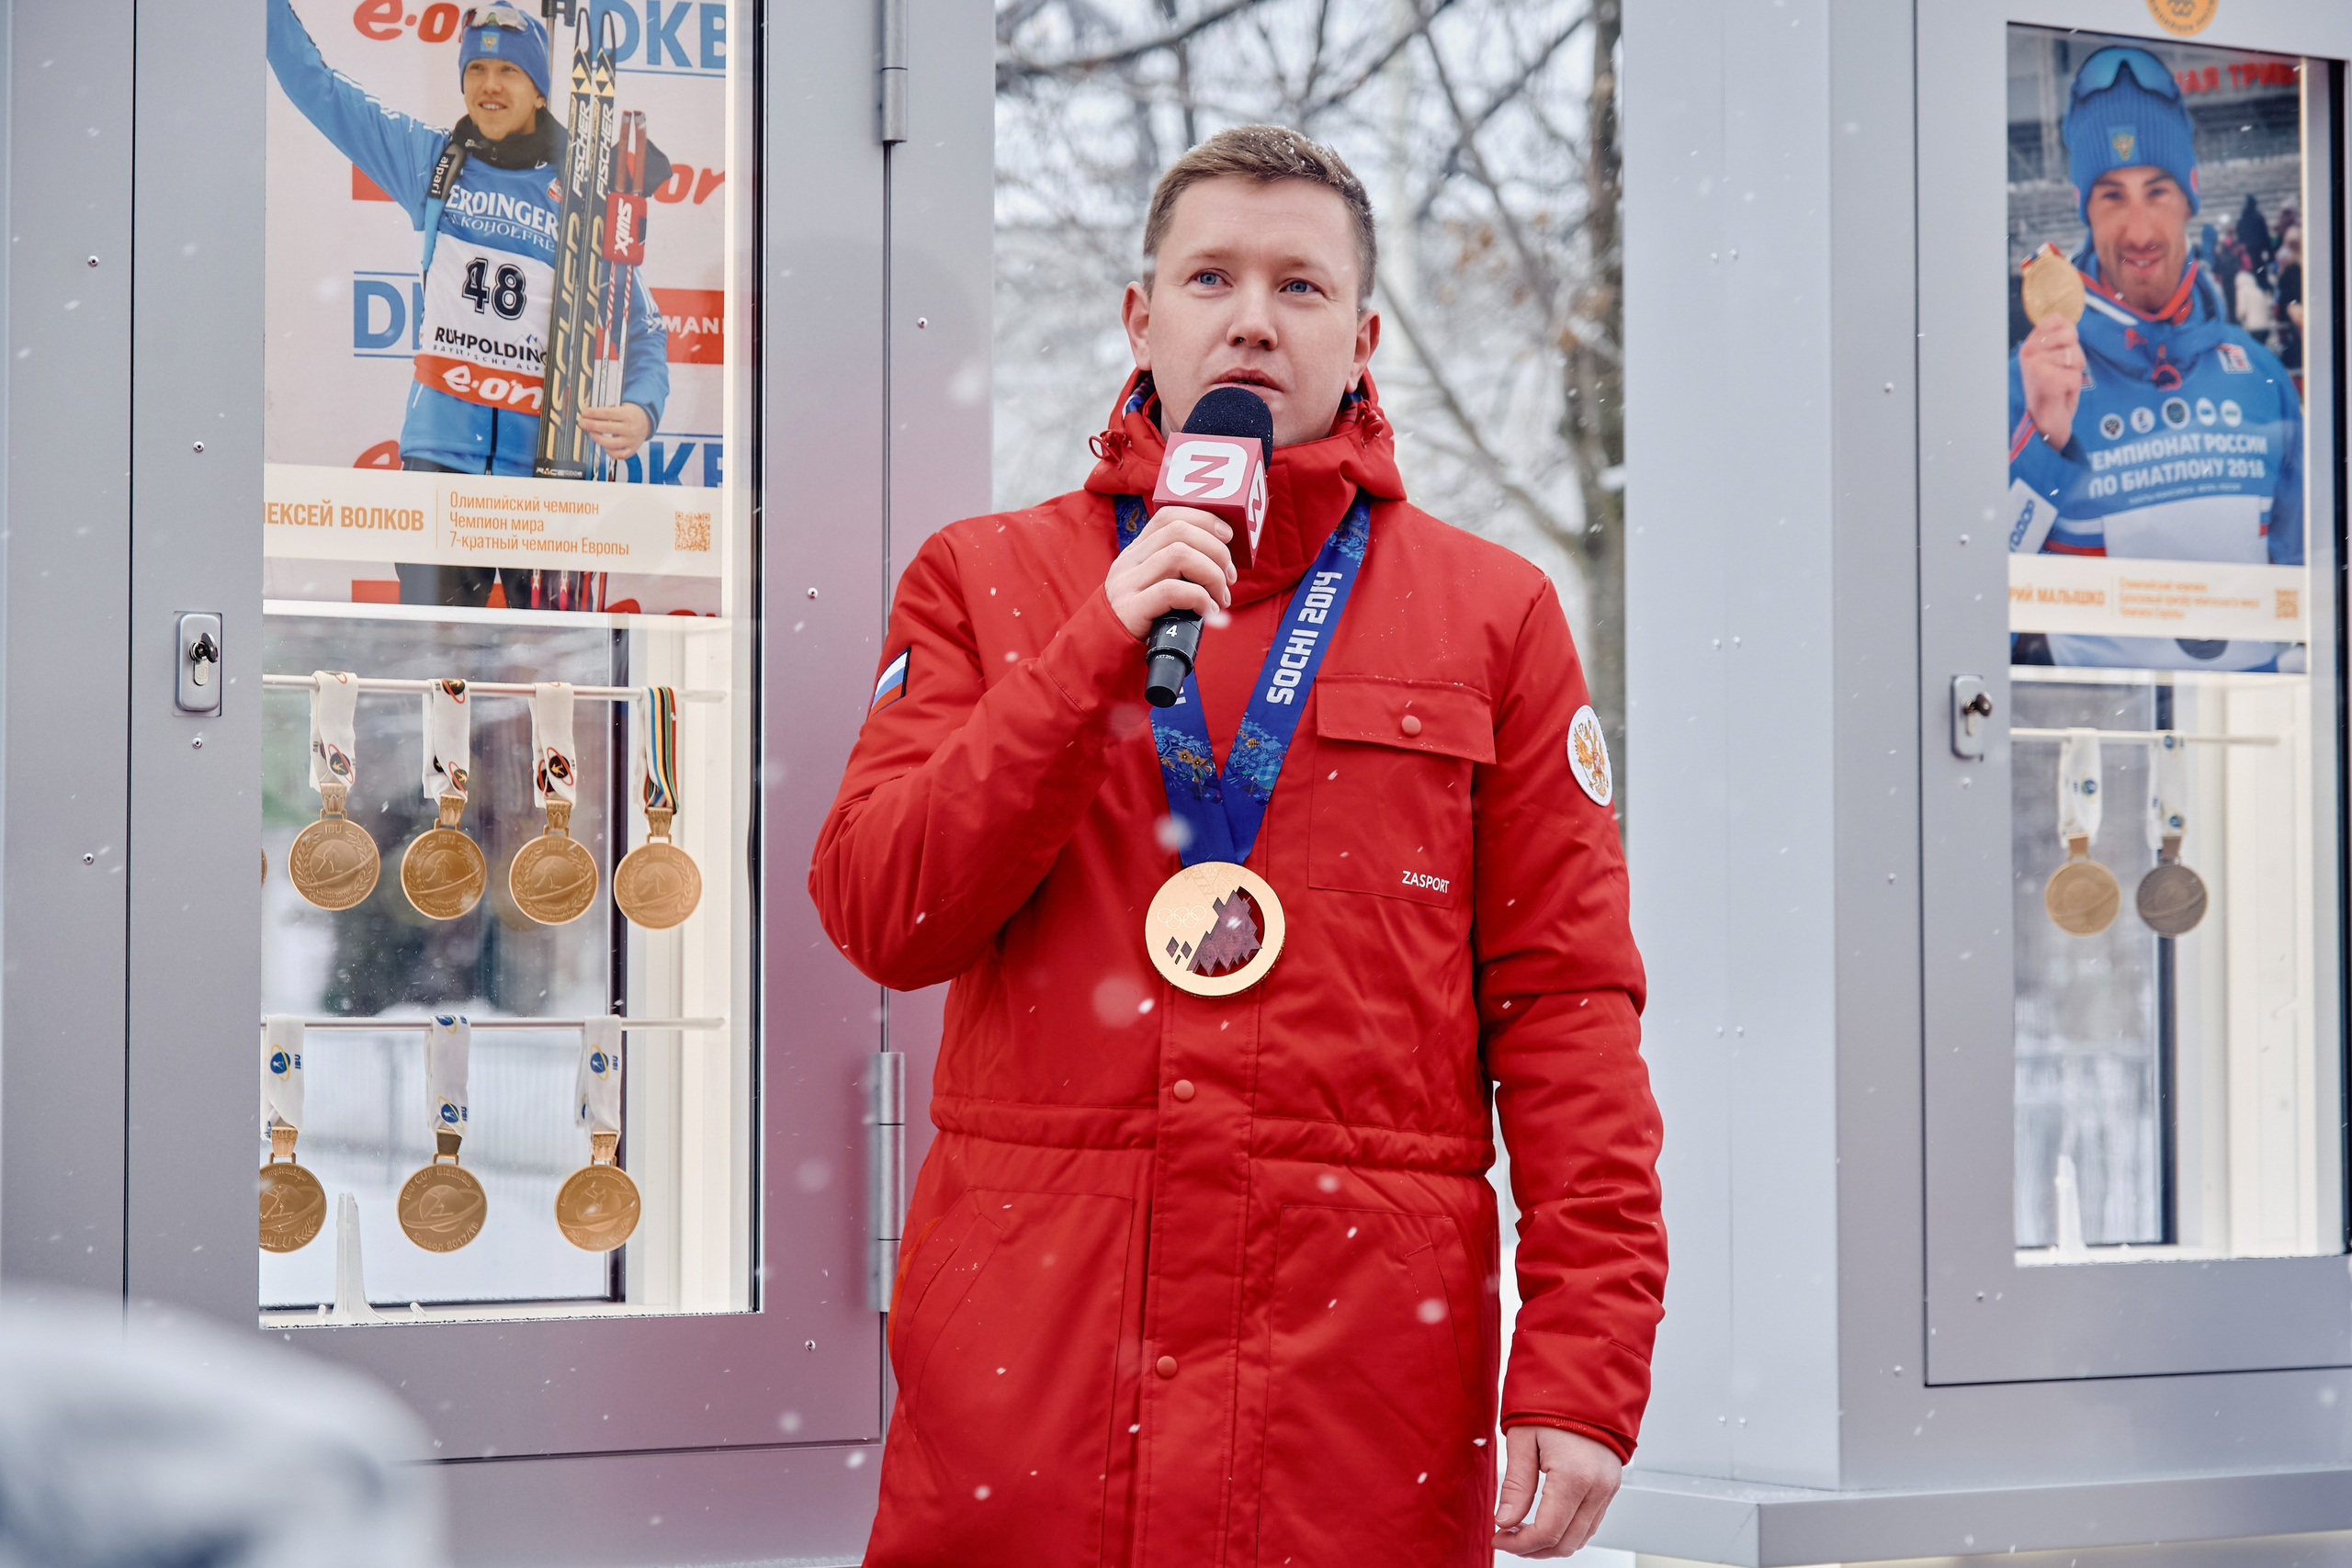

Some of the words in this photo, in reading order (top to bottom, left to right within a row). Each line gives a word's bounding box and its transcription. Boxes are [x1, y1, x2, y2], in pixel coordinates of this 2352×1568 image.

[2227, 62, 2295, 89] ТРИБ
[572, 100, 592, 198] FISCHER
[596, 103, 614, 201] FISCHER
[431, 156, 449, 195] alpari
[445, 185, 559, 243] ERDINGER
[462, 257, 527, 321] 48
[2203, 433, 2268, 455] РОССИИ
[2088, 474, 2118, 499] ПО
[2120, 458, 2224, 493] БИАТЛОНУ
[450, 491, 539, 512] Олимпийский
[543, 500, 599, 515] чемпион
[341, 506, 424, 531] ВОЛКОВ
[450, 512, 507, 530] Чемпион
[511, 519, 545, 535] мира
[450, 531, 518, 551] 7-кратный
[522, 539, 578, 553] чемпион
[582, 536, 629, 557] Европы
[1165, 625, 1178, 637] 4
[1266, 628, 1319, 705] SOCHI
[1297, 570, 1343, 625] 2014
[324, 824, 343, 835] IBU
[1401, 870, 1450, 894] ZASPORT
[414, 1169, 433, 1186] CUP
[436, 1167, 472, 1188] Biathlon
[412, 1233, 445, 1250] Season
